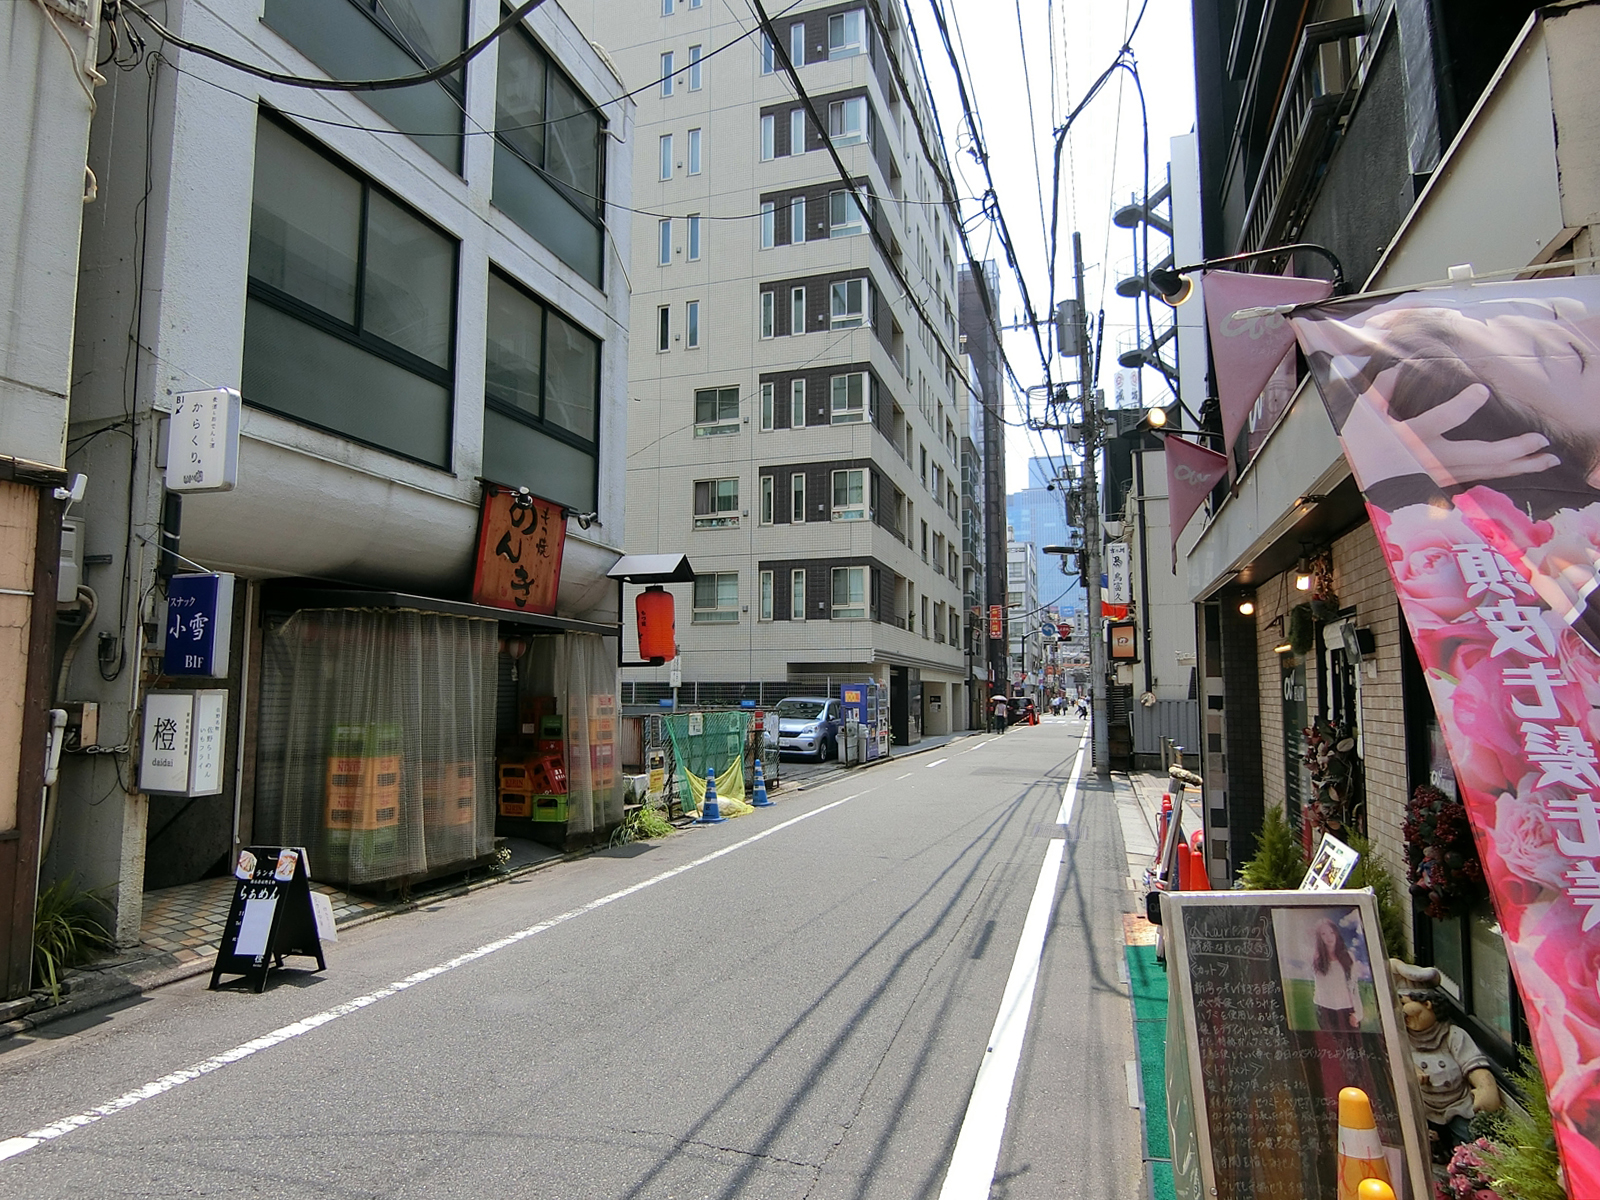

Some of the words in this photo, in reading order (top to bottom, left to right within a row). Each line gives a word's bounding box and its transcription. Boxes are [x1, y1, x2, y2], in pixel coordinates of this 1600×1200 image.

[496, 503, 538, 608] のんき
[169, 596, 196, 607] スナック
[169, 612, 210, 641] 小雪
[152, 717, 177, 751] 橙
[152, 758, 173, 768] daidai
[256, 869, 275, 877] ランチ
